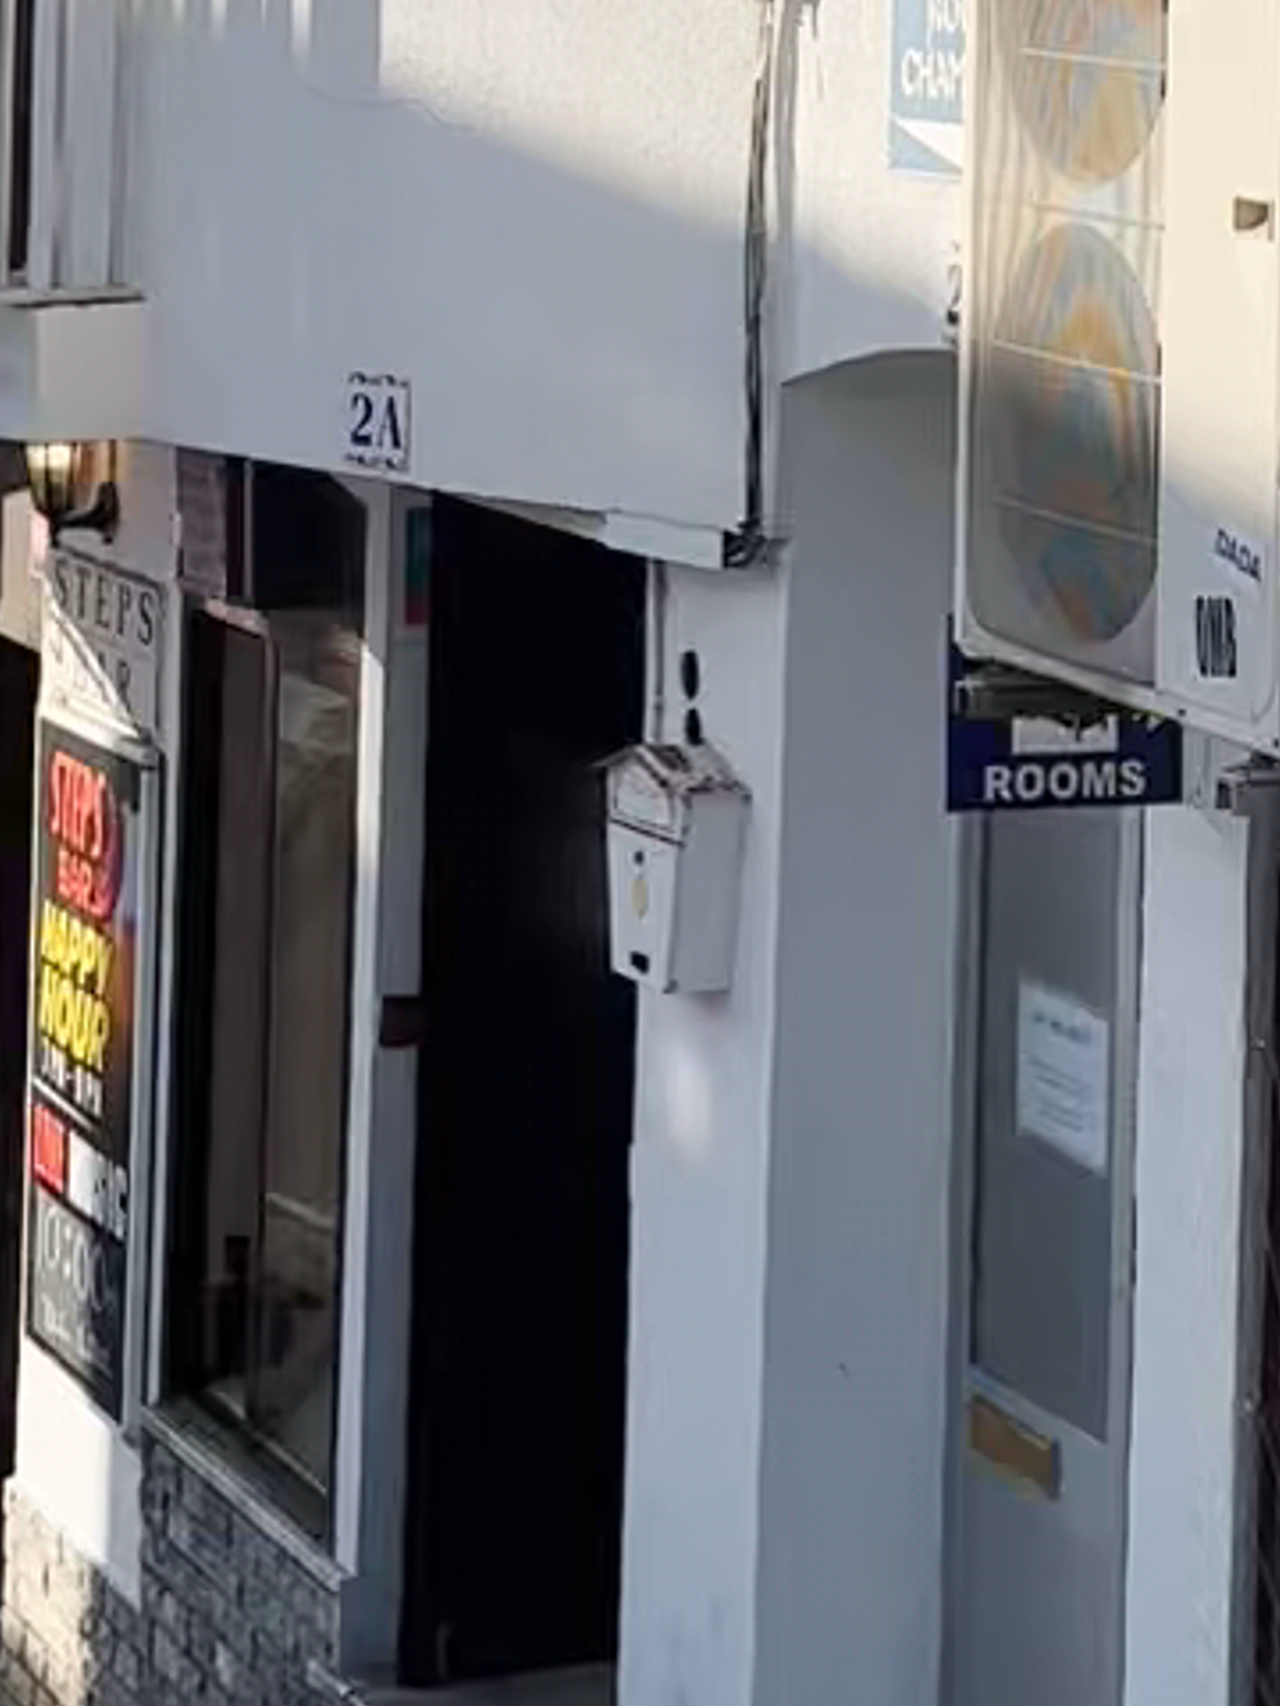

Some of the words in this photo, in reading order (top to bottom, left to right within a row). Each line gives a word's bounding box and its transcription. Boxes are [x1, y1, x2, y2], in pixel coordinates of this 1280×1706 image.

[350, 392, 401, 450] 2A
[52, 557, 154, 647] STEPS
[51, 750, 107, 857] STEPS
[984, 758, 1146, 802] ROOMS
[42, 899, 114, 996] HAPPY
[41, 963, 111, 1073] HOUR
